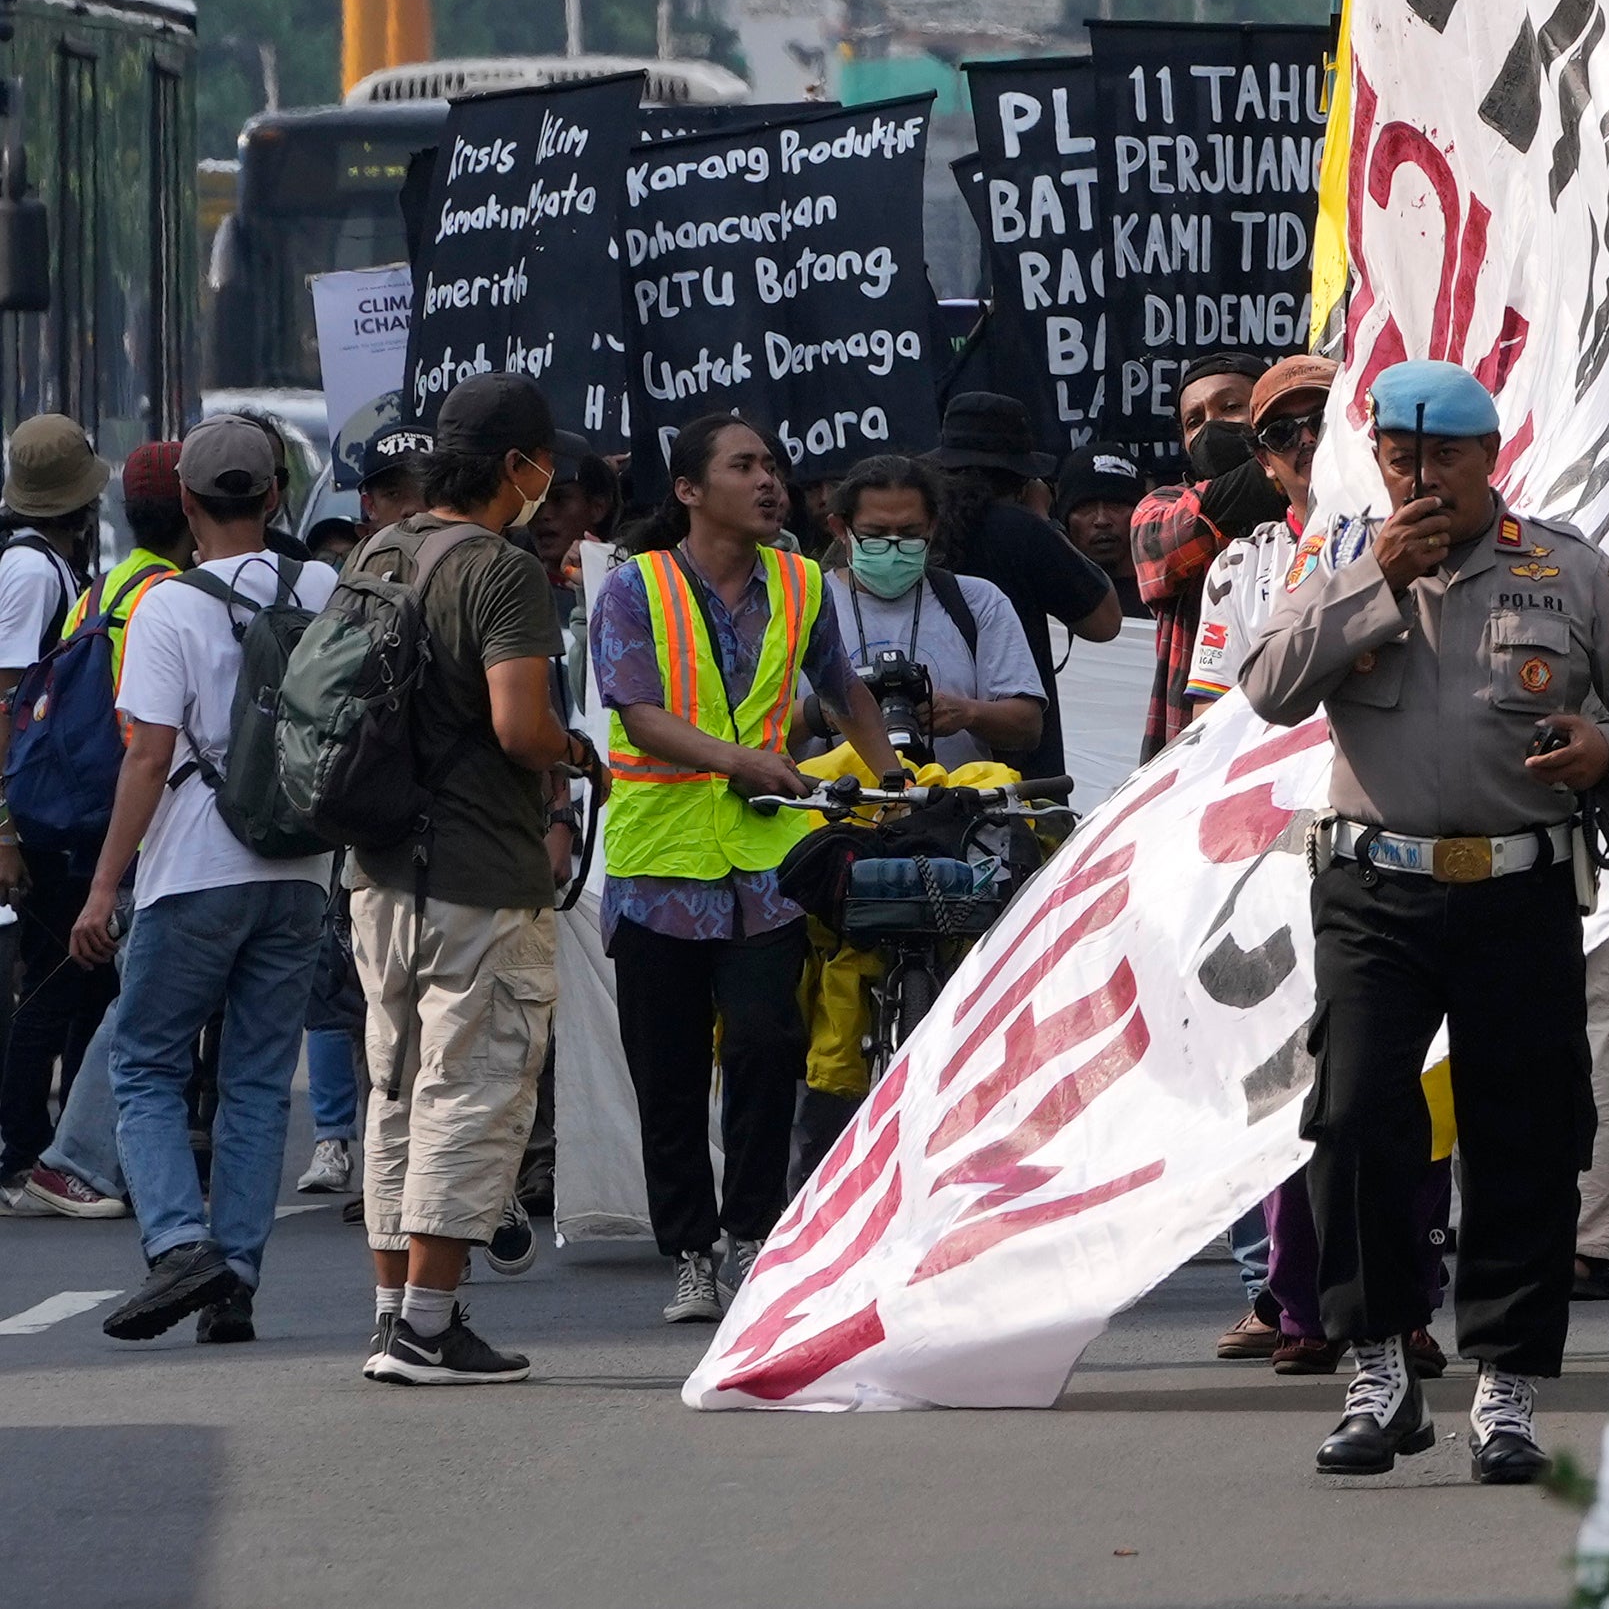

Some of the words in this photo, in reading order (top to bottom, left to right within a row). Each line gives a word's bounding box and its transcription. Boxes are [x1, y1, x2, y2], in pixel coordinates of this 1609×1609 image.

[1128, 64, 1175, 125] 11
[1111, 212, 1213, 279] KAMI
[633, 265, 736, 326] PLTU
[764, 329, 922, 382] Dermaga
[1499, 591, 1564, 613] POLRI
